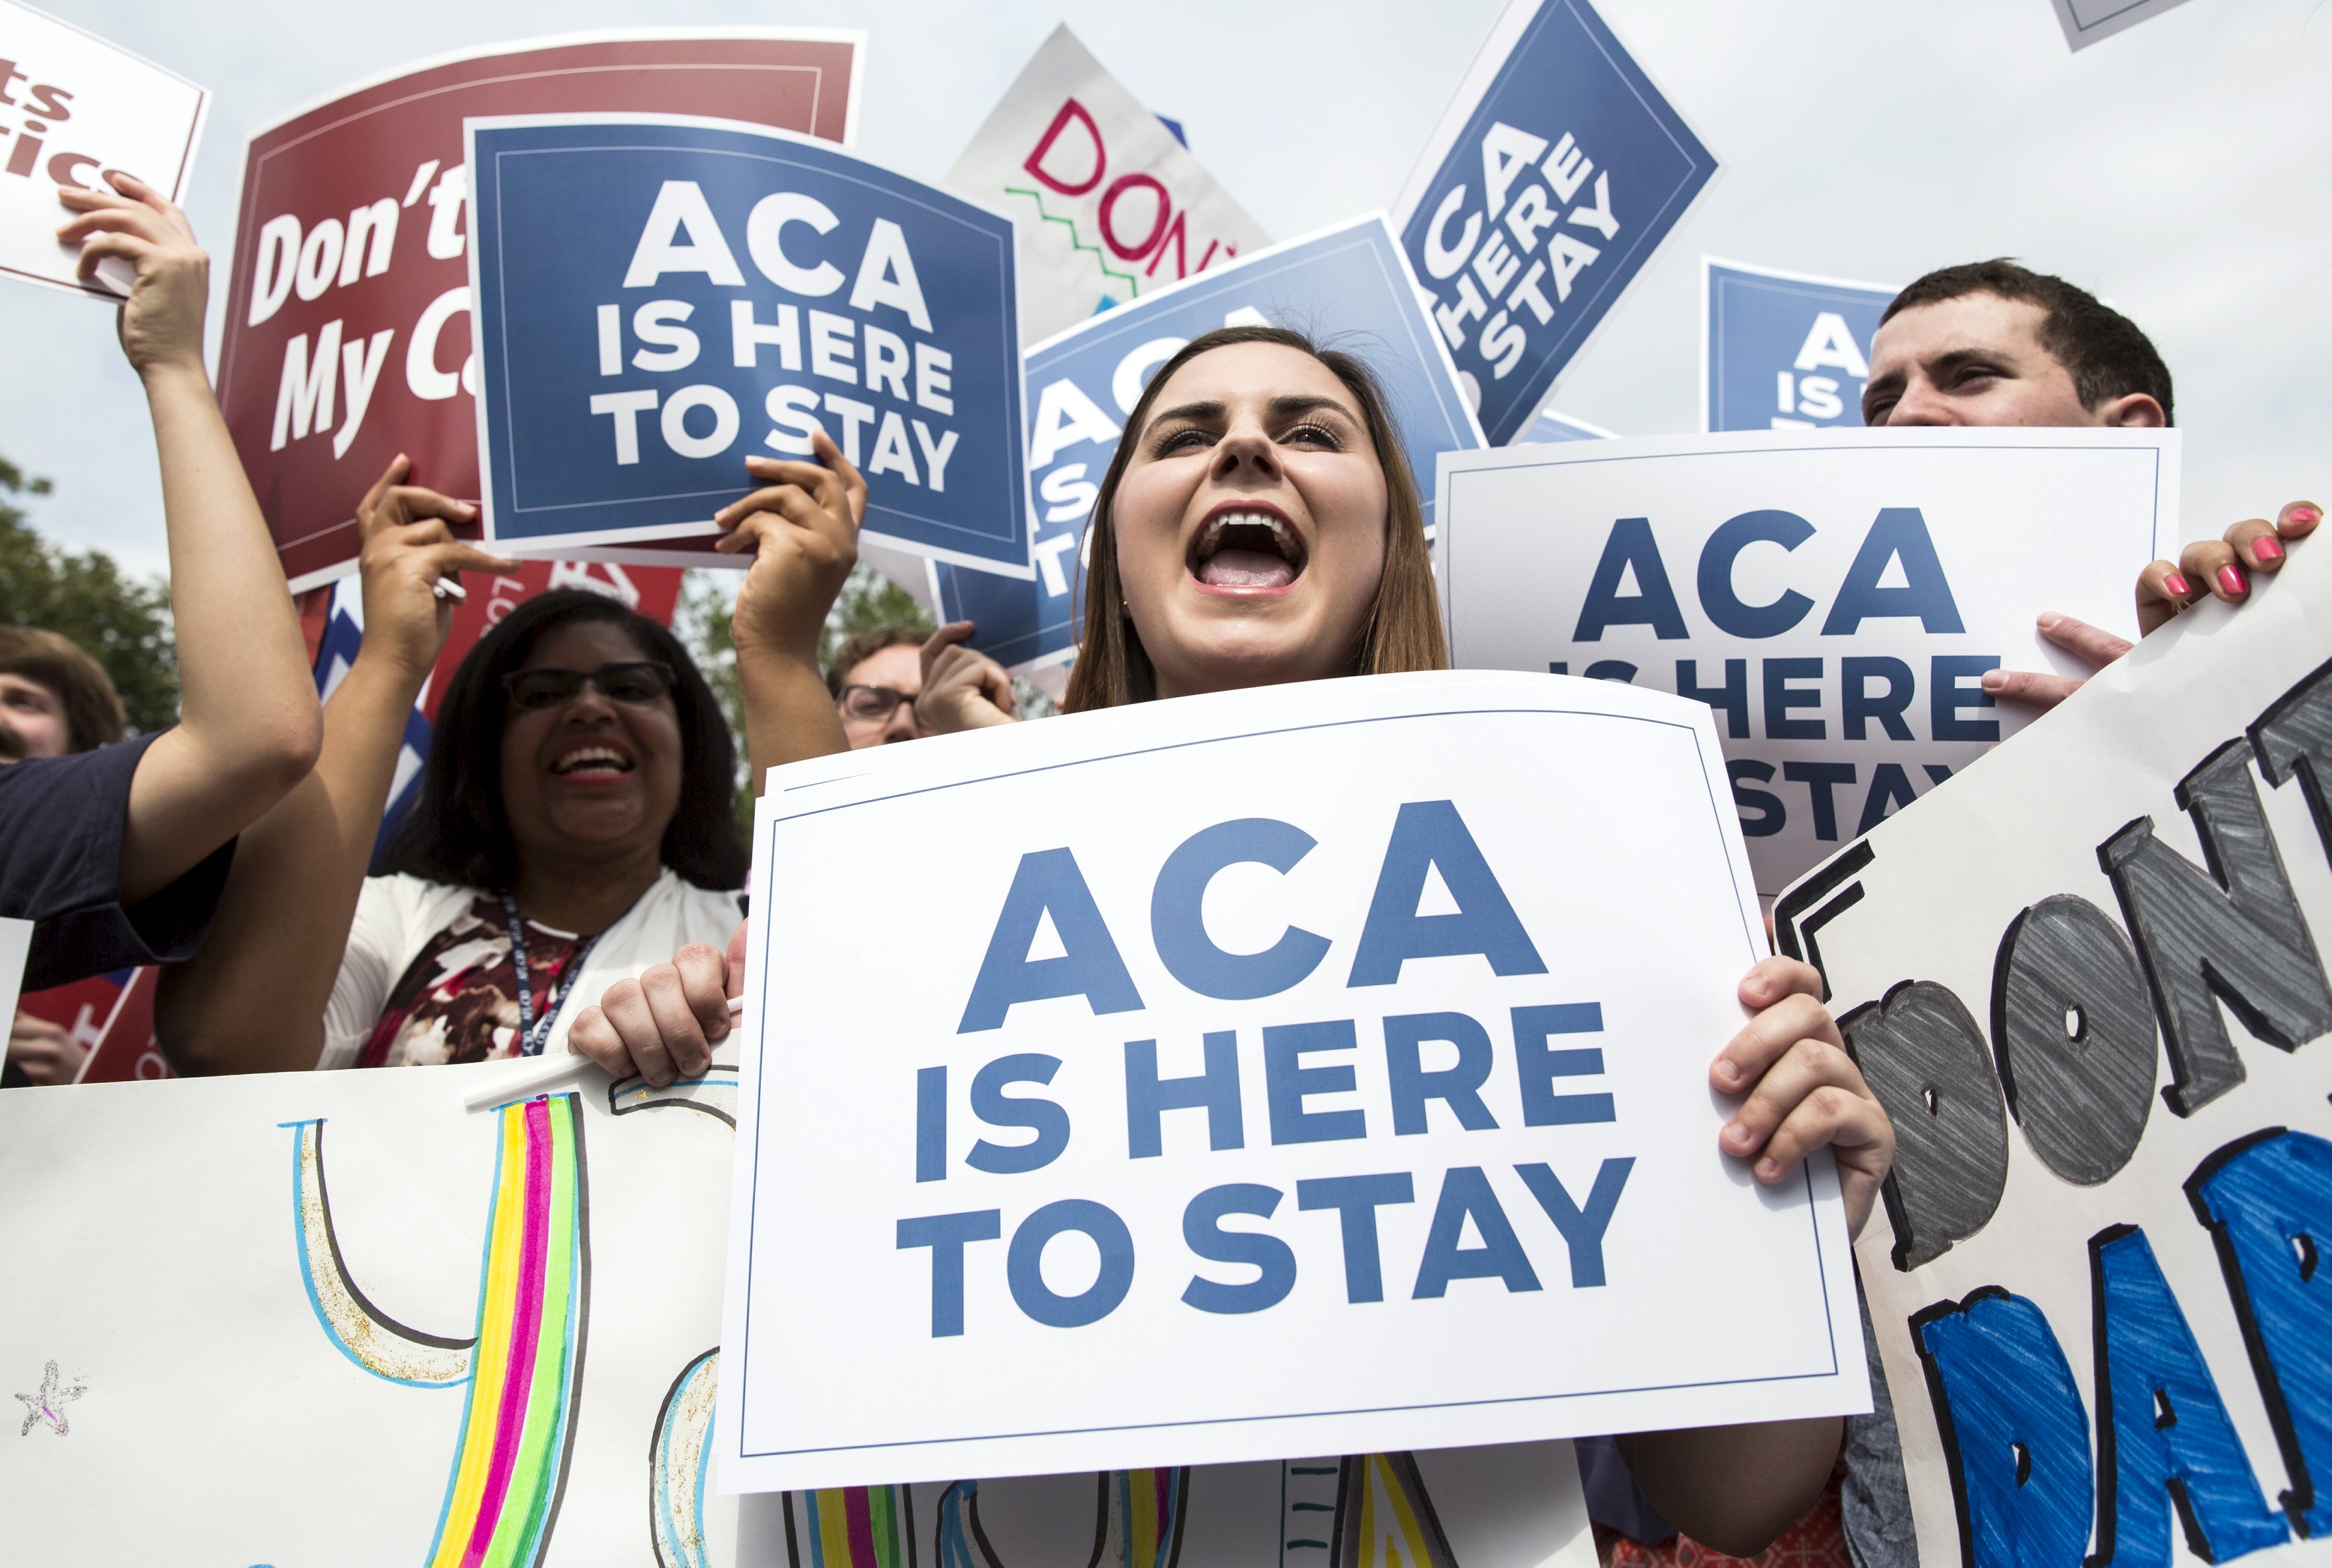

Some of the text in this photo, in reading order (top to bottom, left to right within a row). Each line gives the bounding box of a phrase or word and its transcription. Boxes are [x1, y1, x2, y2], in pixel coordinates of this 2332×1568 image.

[247, 159, 466, 328] Don't
[622, 179, 933, 334] ACA
[1435, 131, 1595, 352] HERE
[1478, 169, 1621, 380] STAY
[271, 318, 395, 461] My
[597, 299, 954, 417] IS HERE
[1777, 370, 1844, 420] IS
[589, 384, 959, 493] TO STAY
[1572, 507, 1966, 642] ACA
[1675, 655, 2002, 742] HERE
[956, 799, 1550, 1034] ACA
[915, 1001, 1616, 1183] IS HERE
[896, 1156, 1637, 1338] TO STAY
